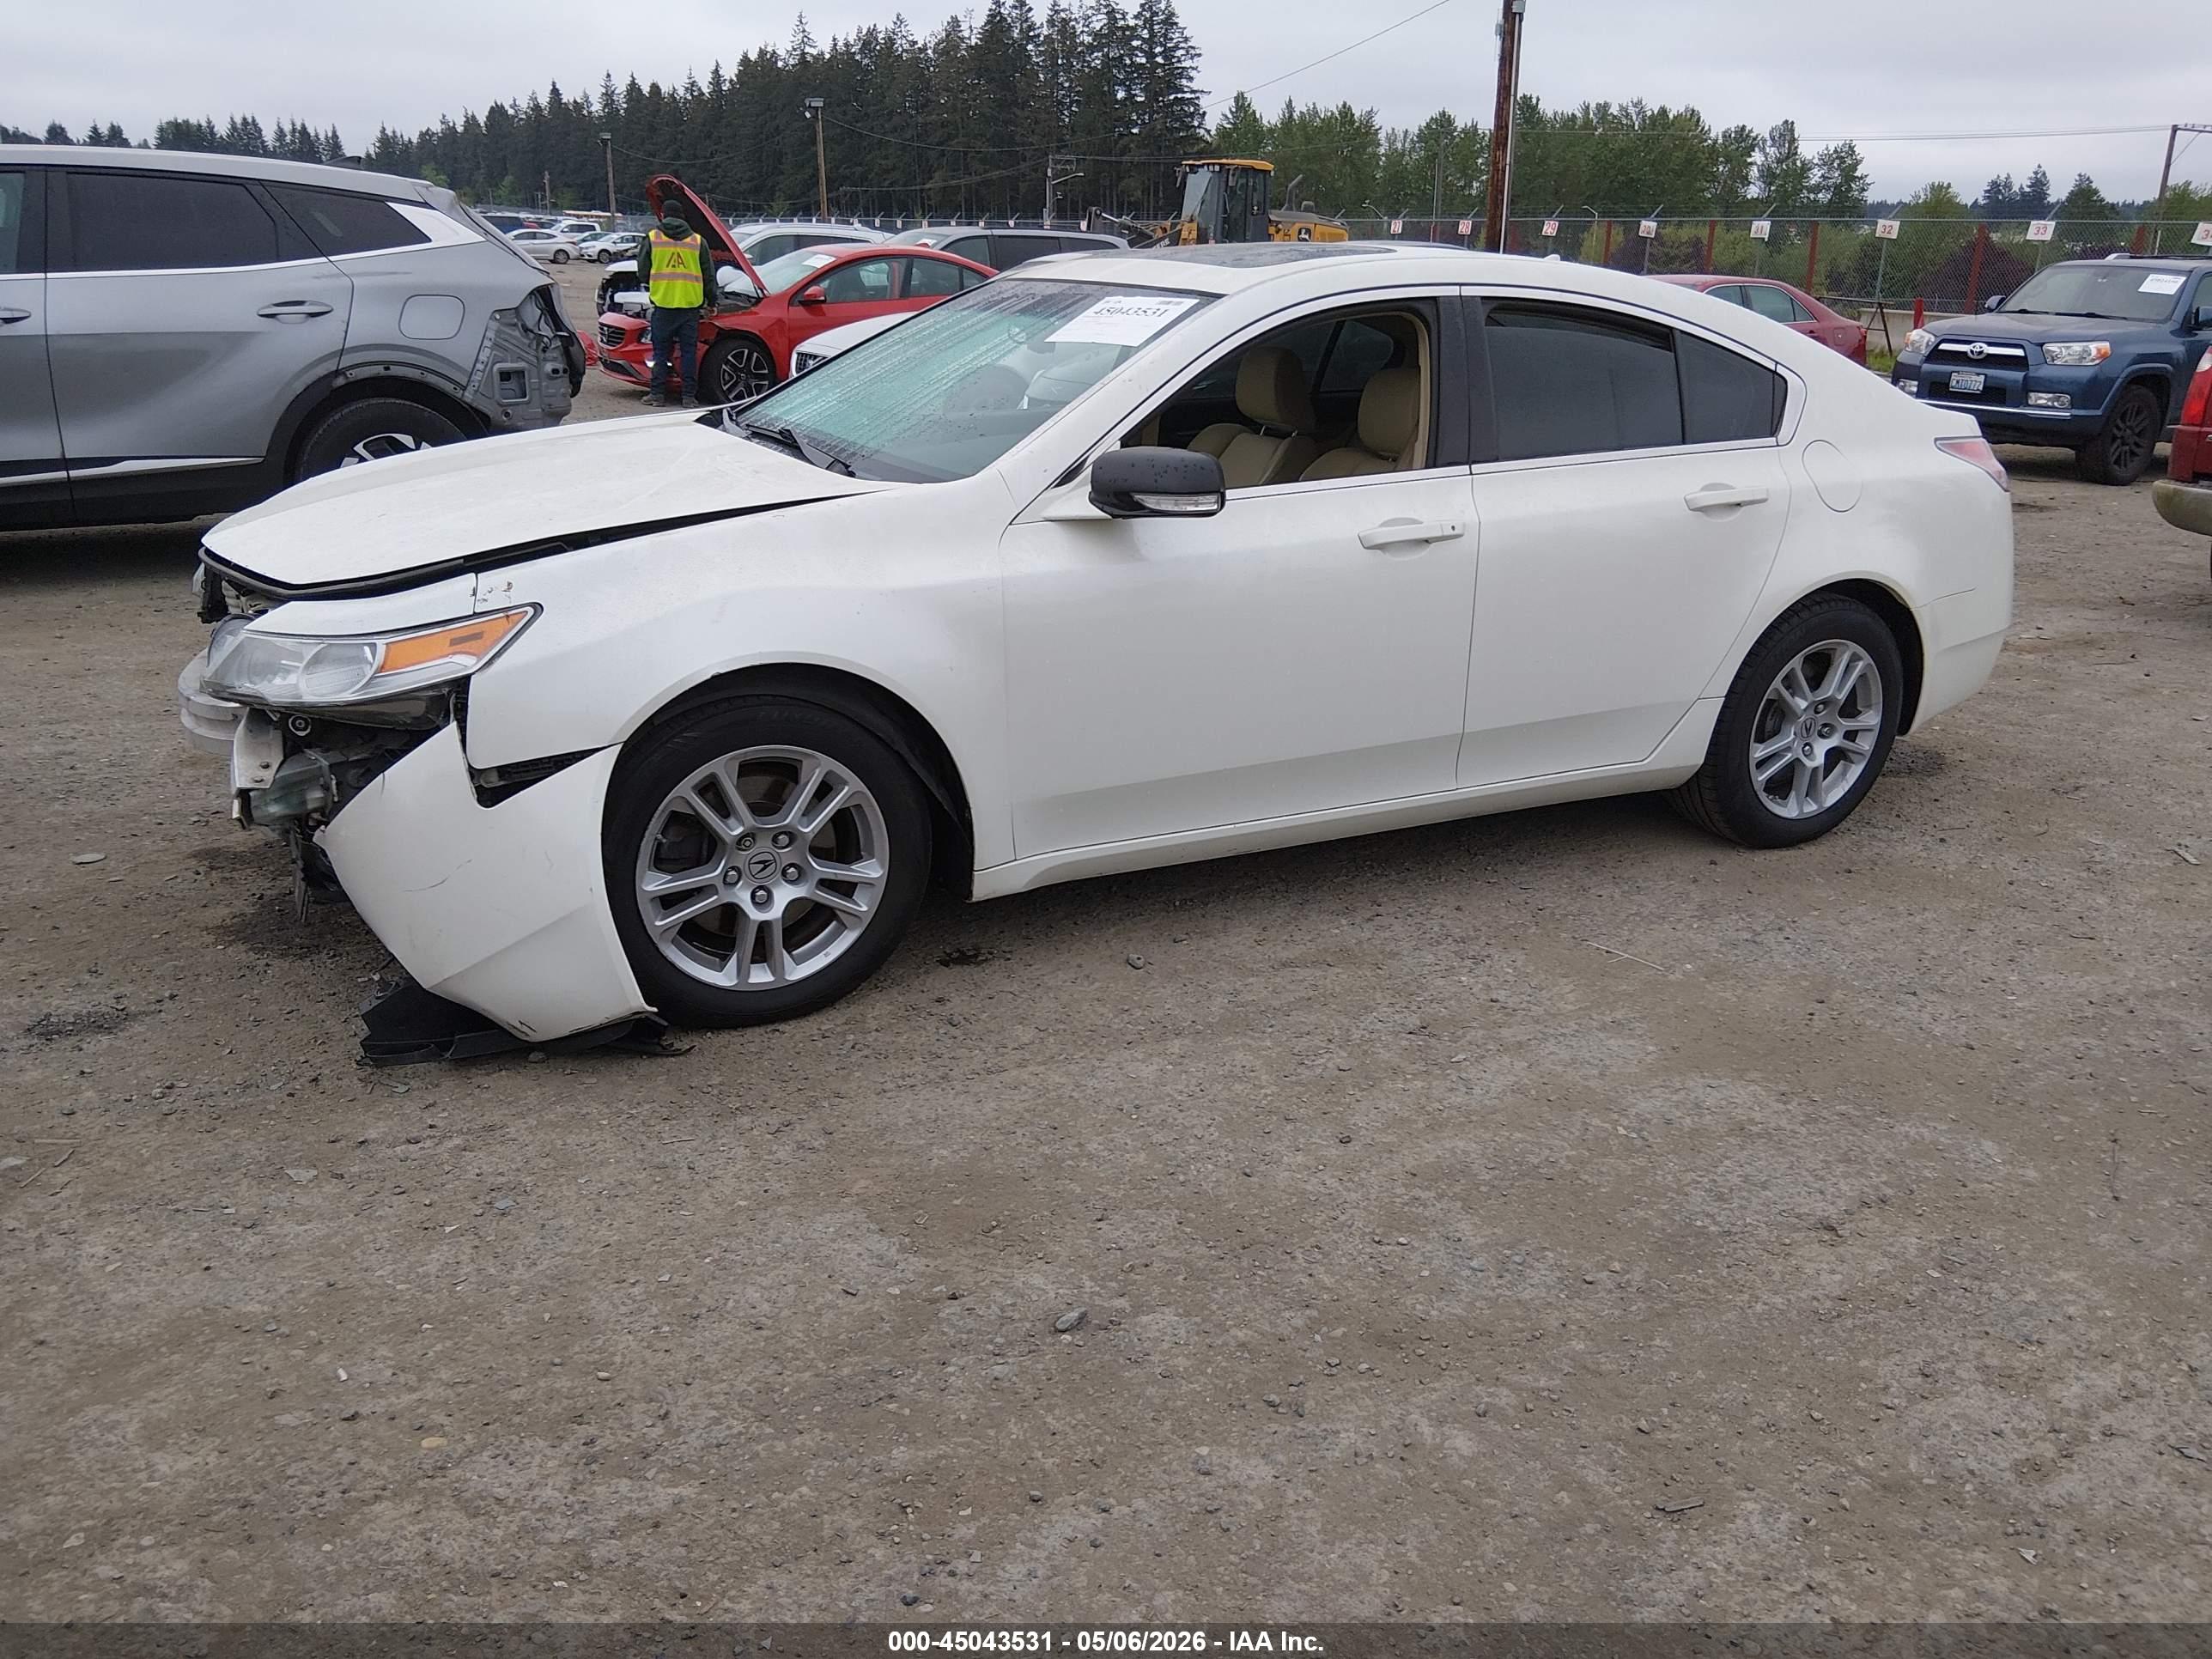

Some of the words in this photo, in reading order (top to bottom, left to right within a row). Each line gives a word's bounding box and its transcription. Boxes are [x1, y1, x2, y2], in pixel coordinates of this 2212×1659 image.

[1392, 221, 1401, 233] 27
[1460, 221, 1470, 234] 28
[1545, 222, 1557, 234] 29
[1881, 224, 1893, 234] 32
[2033, 226, 2048, 235] 33
